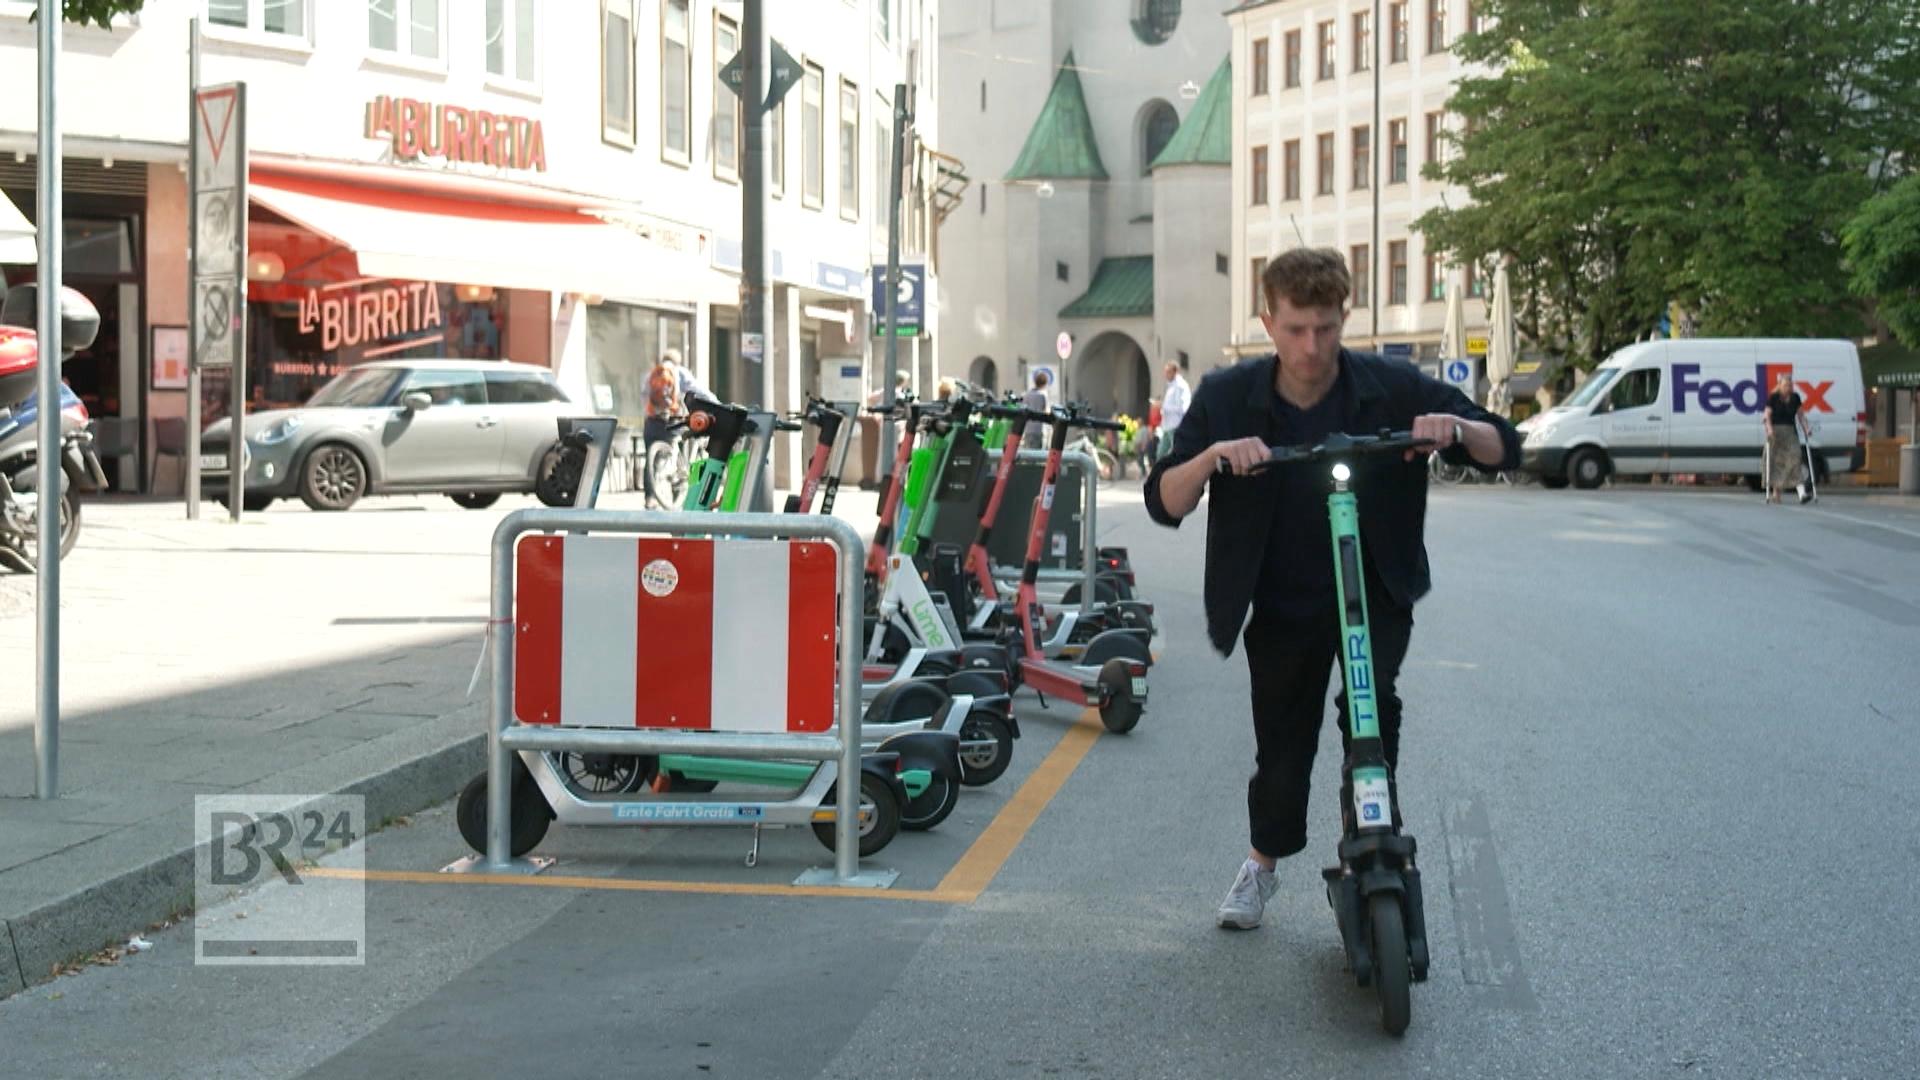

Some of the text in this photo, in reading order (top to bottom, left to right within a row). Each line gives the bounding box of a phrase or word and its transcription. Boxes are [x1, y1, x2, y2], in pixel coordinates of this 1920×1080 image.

[299, 288, 320, 334] LA
[911, 599, 945, 647] Lime
[617, 805, 653, 817] Erste
[655, 805, 690, 817] Fahrt
[693, 805, 734, 817] Gratis
